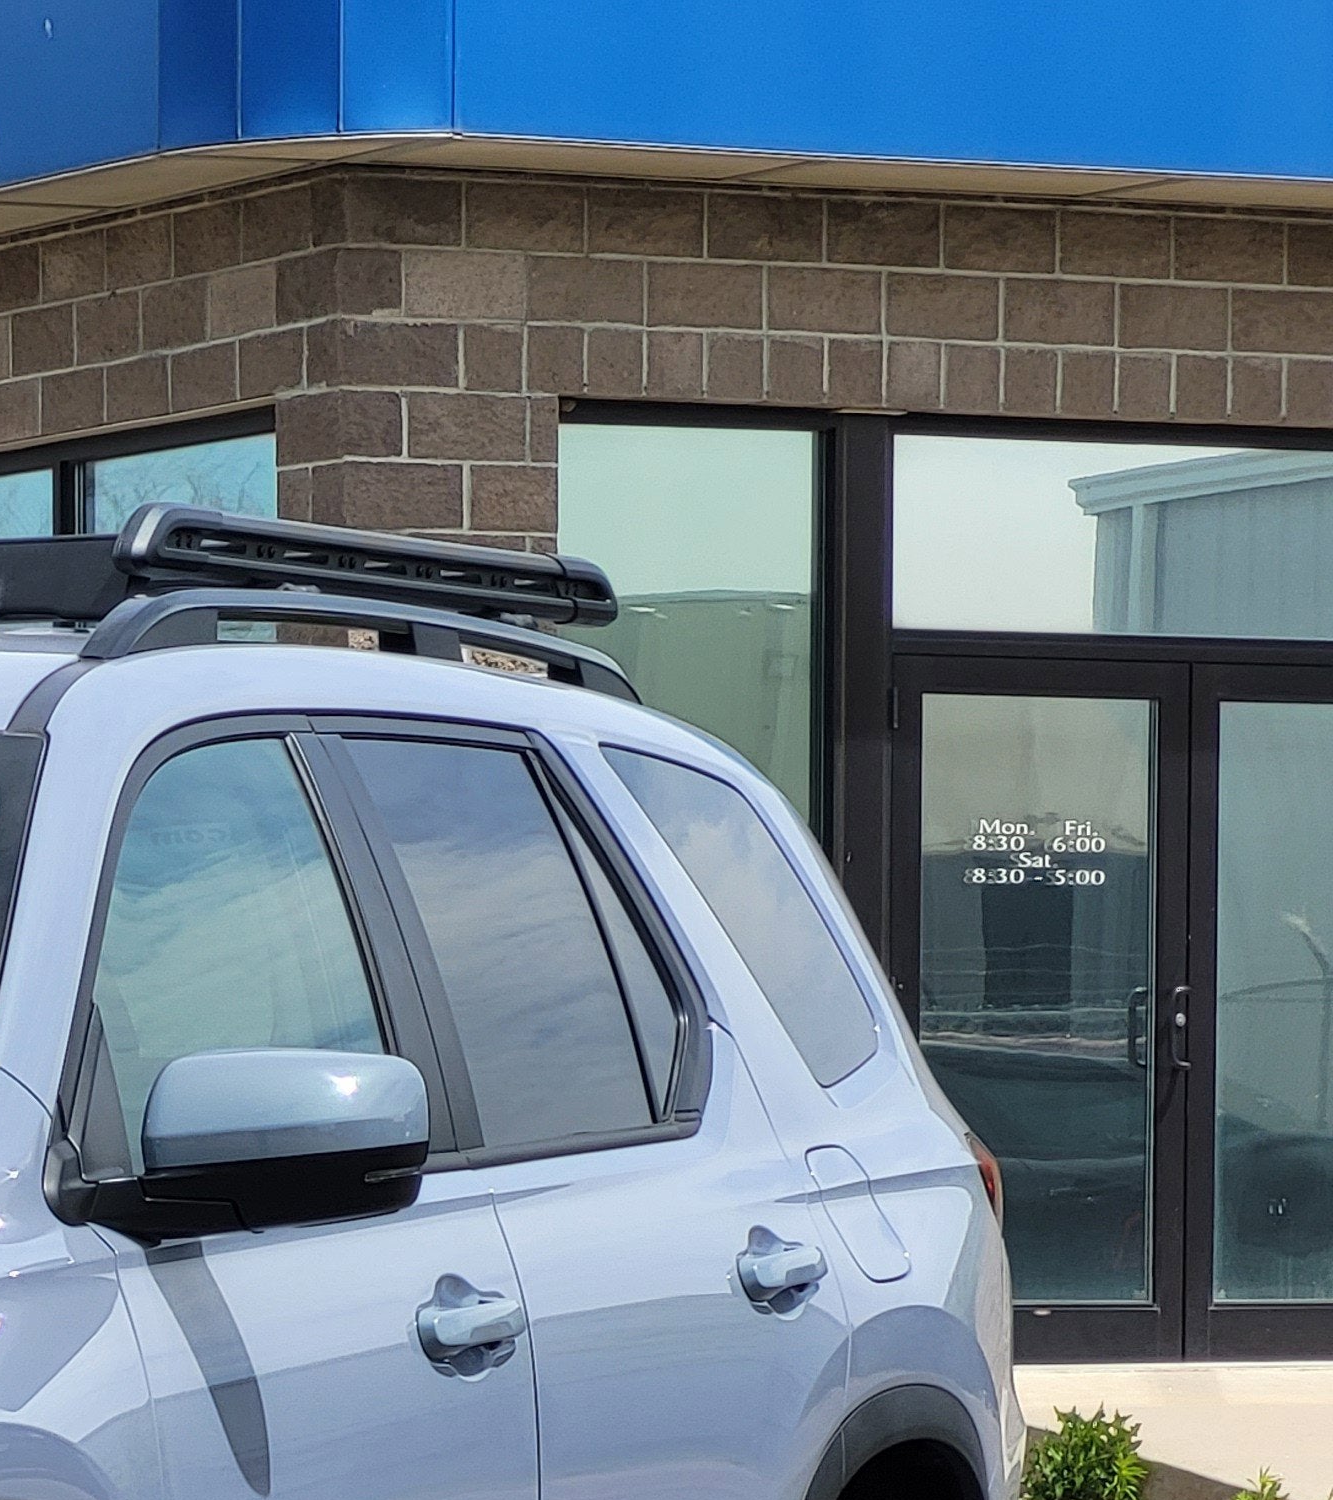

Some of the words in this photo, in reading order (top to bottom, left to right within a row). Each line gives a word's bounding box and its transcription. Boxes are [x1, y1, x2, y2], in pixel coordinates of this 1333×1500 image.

[978, 818, 1036, 836] Mon.
[1064, 820, 1099, 837] Fri.
[972, 835, 1025, 851] 8:30
[1052, 836, 1106, 853] 6:00
[1018, 851, 1059, 869] Sat.
[972, 868, 1025, 884] 8:30
[1053, 868, 1106, 886] 5:00
